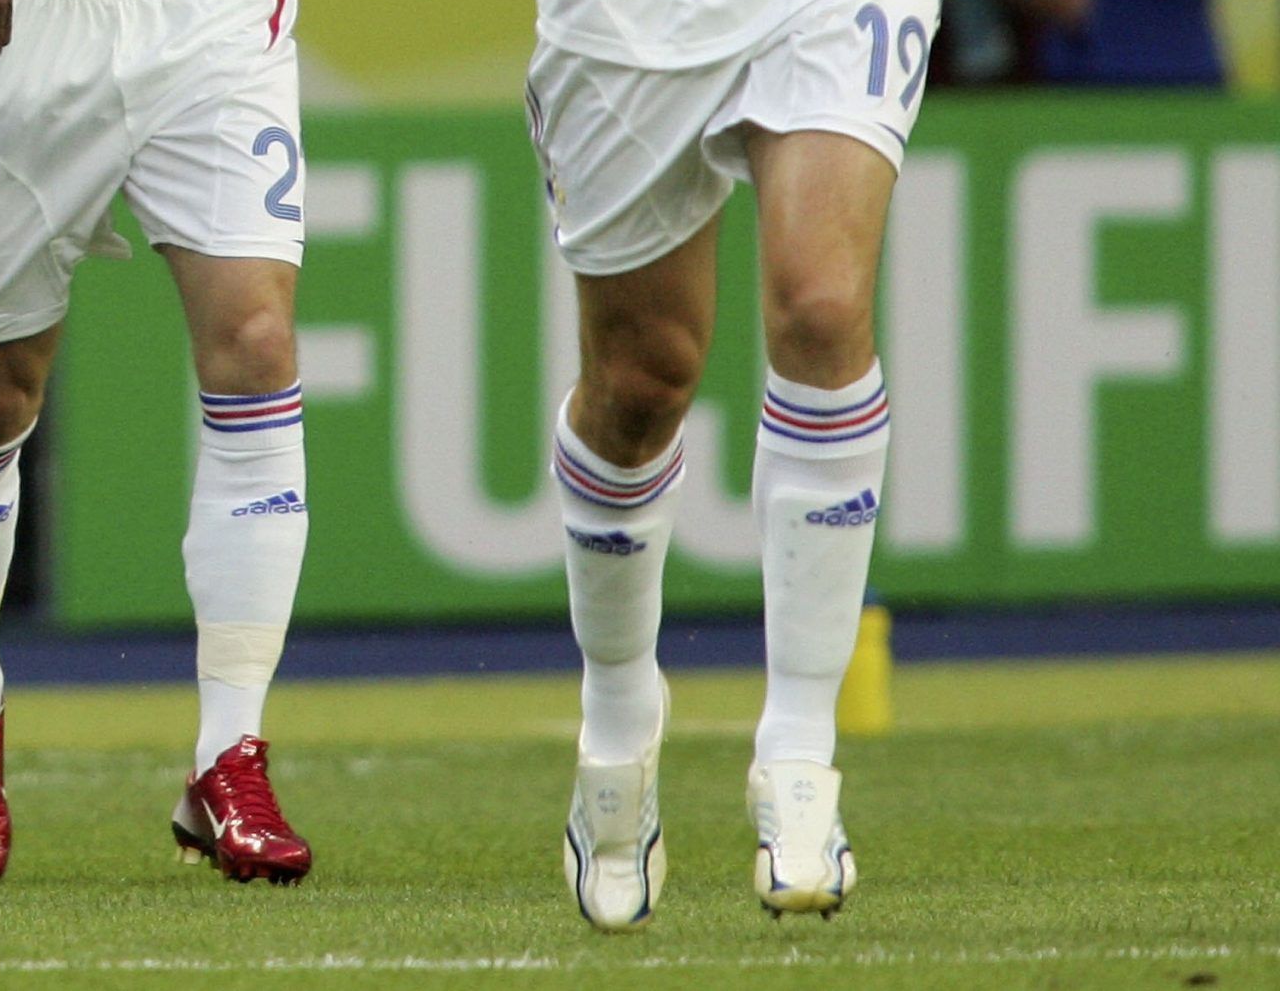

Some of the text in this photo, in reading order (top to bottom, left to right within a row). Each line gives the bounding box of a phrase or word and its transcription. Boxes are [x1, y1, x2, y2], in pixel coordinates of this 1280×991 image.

[854, 2, 928, 112] 19
[252, 126, 302, 223] 2
[231, 500, 308, 516] adida
